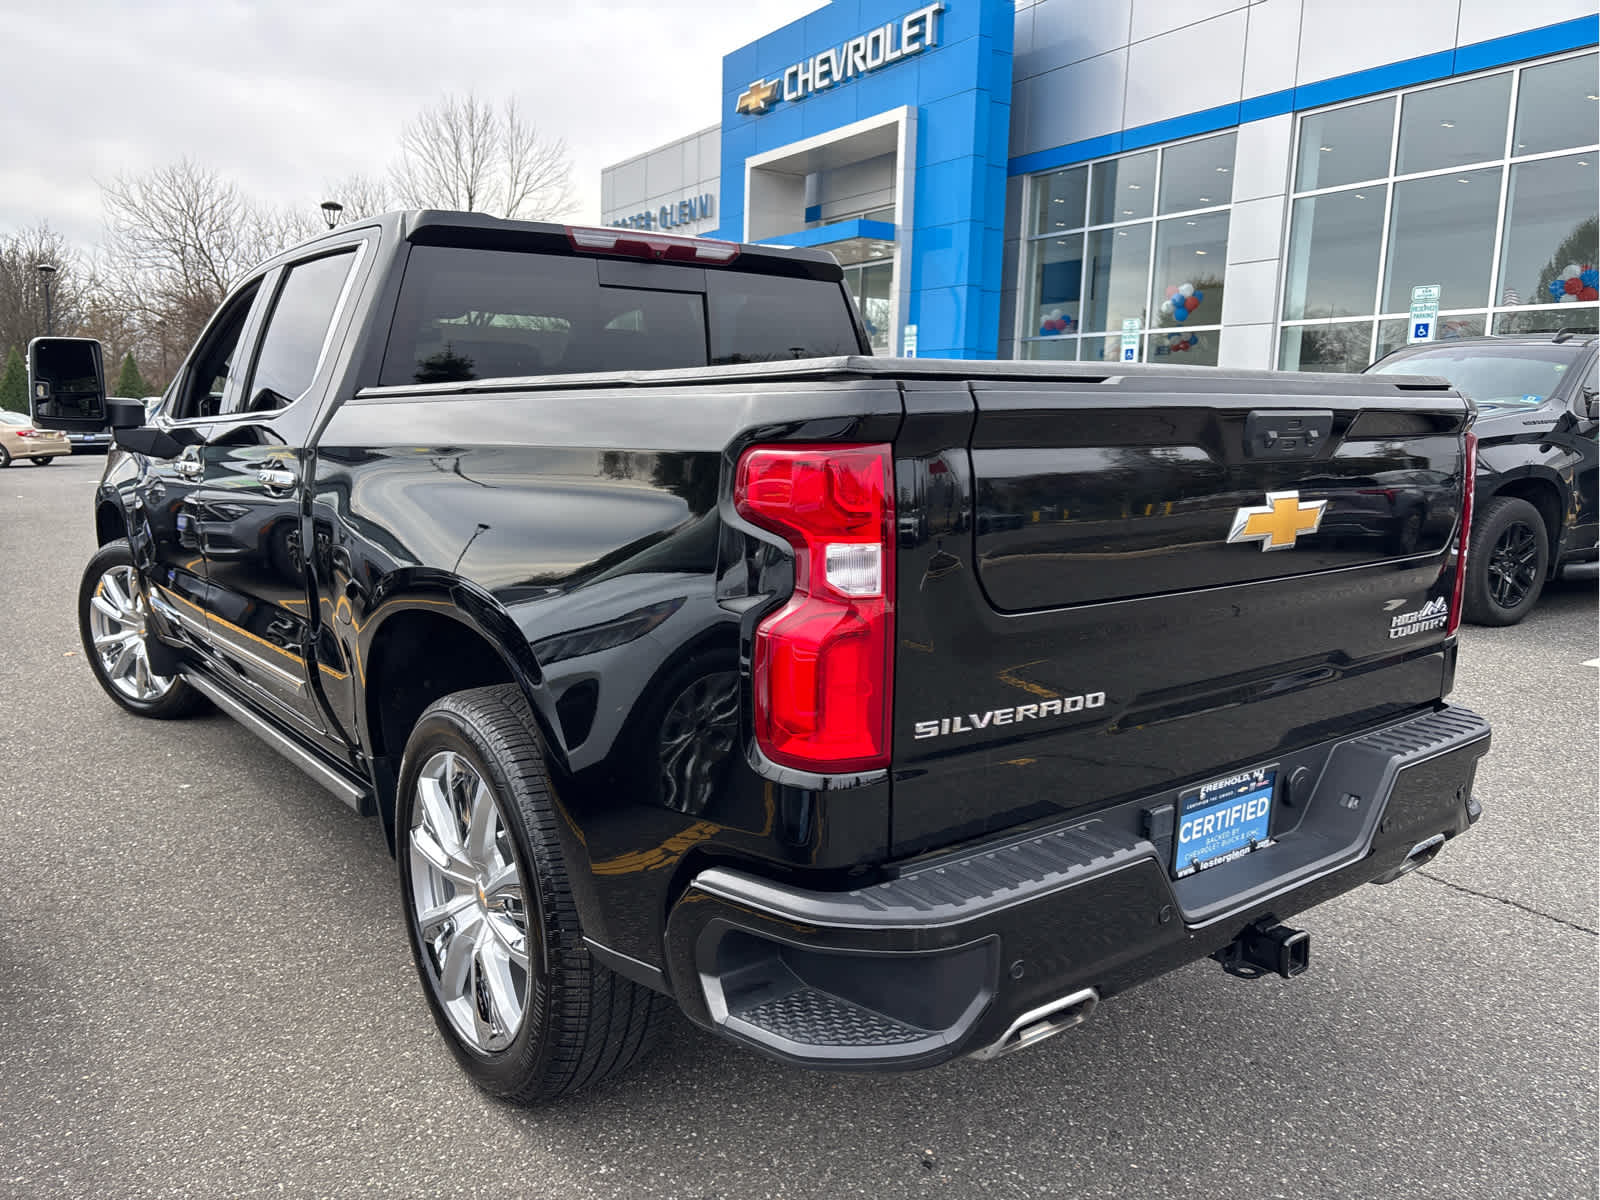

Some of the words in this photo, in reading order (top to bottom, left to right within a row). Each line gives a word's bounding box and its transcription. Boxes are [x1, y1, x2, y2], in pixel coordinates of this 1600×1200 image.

[783, 2, 945, 102] CHEVROLET
[659, 192, 713, 229] GLENN
[1388, 615, 1447, 639] COUNTRY
[914, 691, 1106, 740] SILVERADO
[1179, 796, 1270, 844] CERTIFIED
[1206, 830, 1232, 846] BACKED
[1232, 828, 1240, 837] BY
[1184, 843, 1221, 862] CHEVROLET
